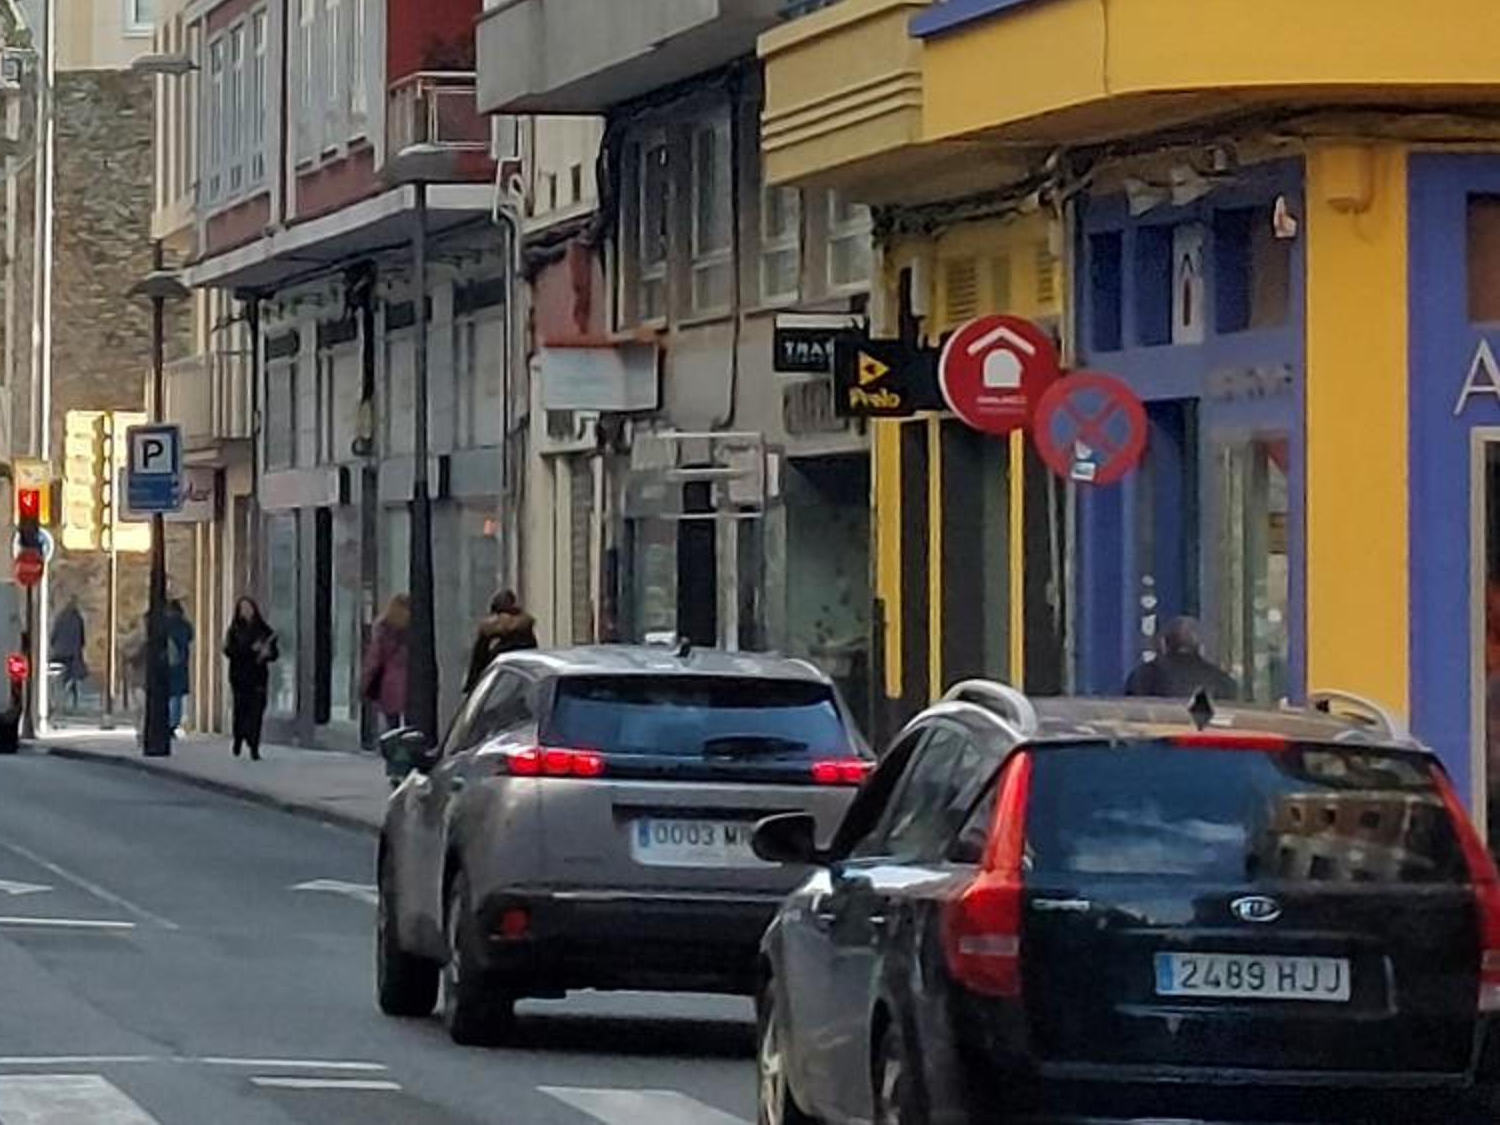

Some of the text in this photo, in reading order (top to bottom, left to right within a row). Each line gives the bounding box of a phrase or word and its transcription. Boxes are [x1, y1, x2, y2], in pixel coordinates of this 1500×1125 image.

[142, 439, 164, 469] P
[653, 824, 716, 846] 0003
[1180, 960, 1342, 993] 2489 HJJ
